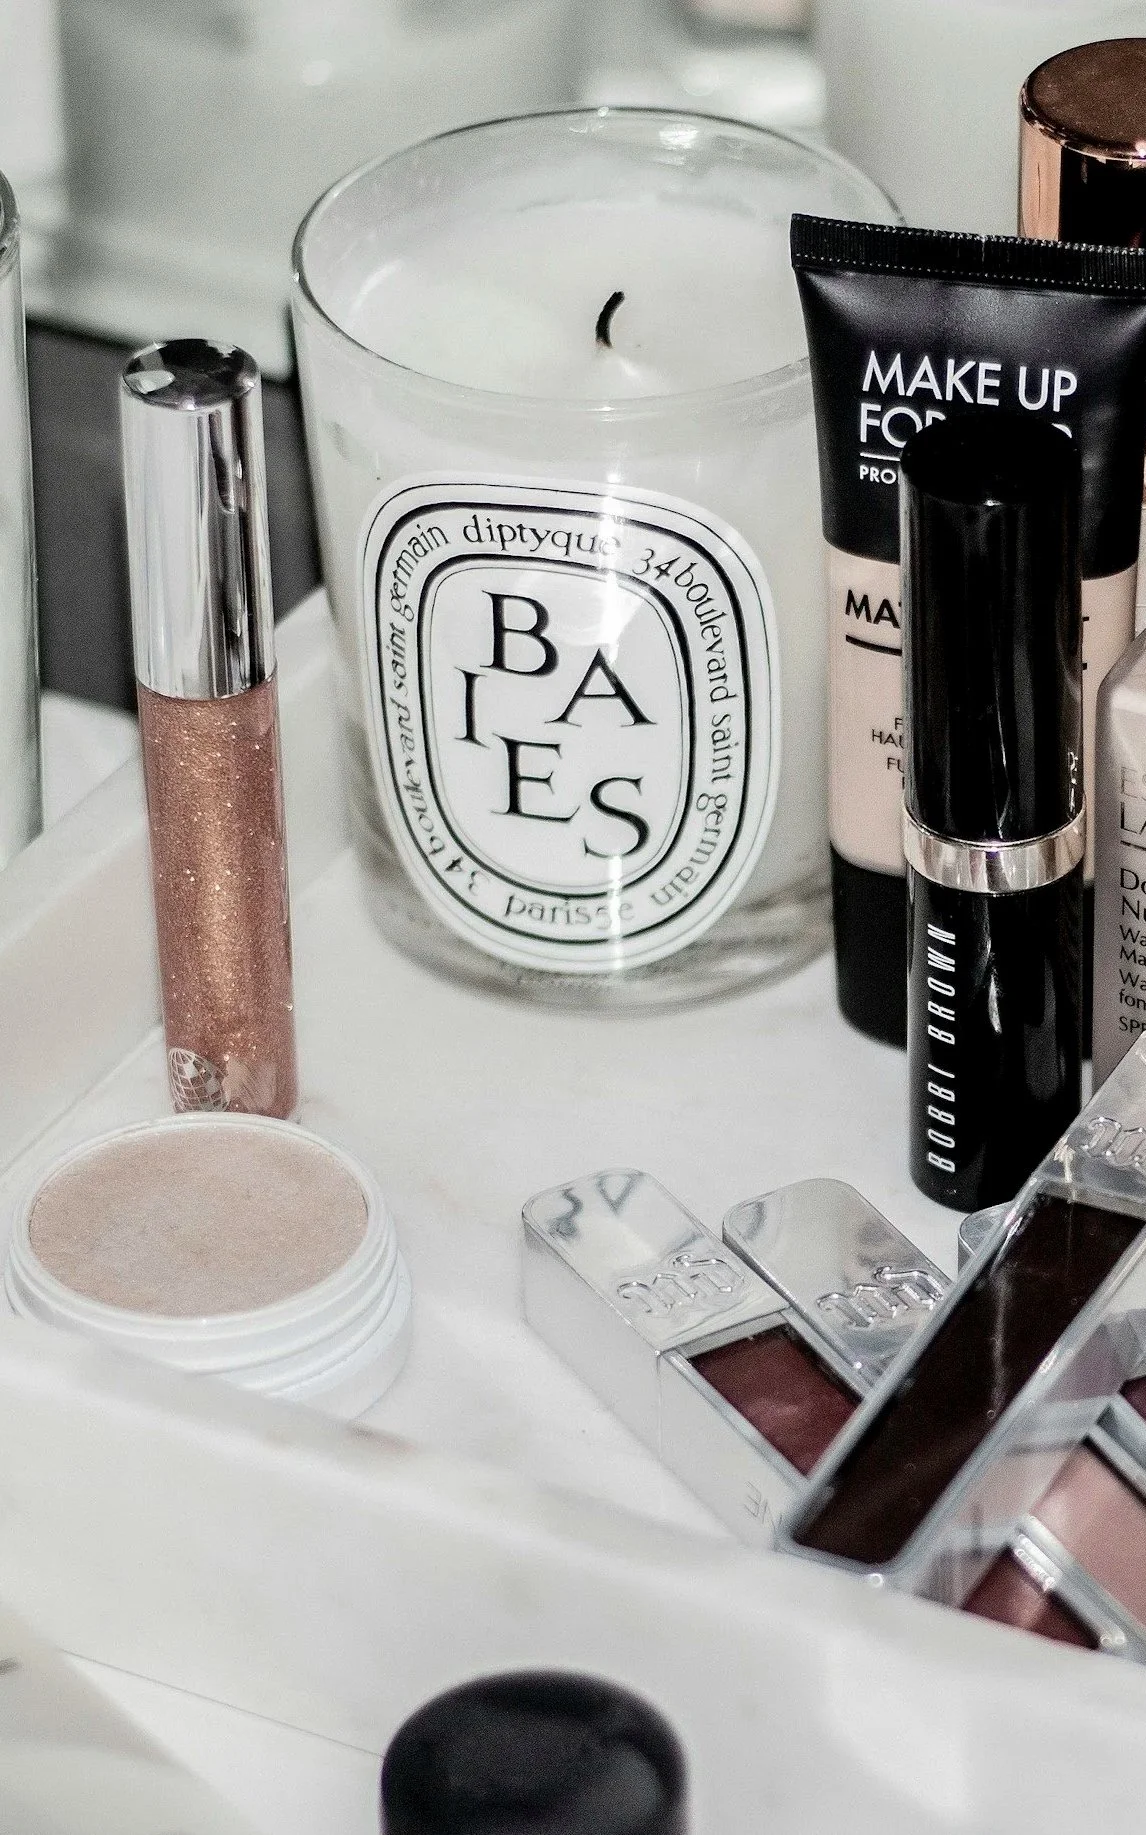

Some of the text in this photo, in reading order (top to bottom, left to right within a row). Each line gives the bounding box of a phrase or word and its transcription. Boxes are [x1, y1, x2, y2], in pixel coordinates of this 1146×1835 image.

[862, 350, 1078, 412] MAKE UP
[463, 514, 622, 557] diptyque
[389, 523, 451, 623] germain
[845, 588, 901, 629] MA
[385, 622, 409, 698] saint
[710, 713, 739, 784] saint
[651, 792, 728, 906] germain
[927, 922, 956, 1173] BOBBI BROWN
